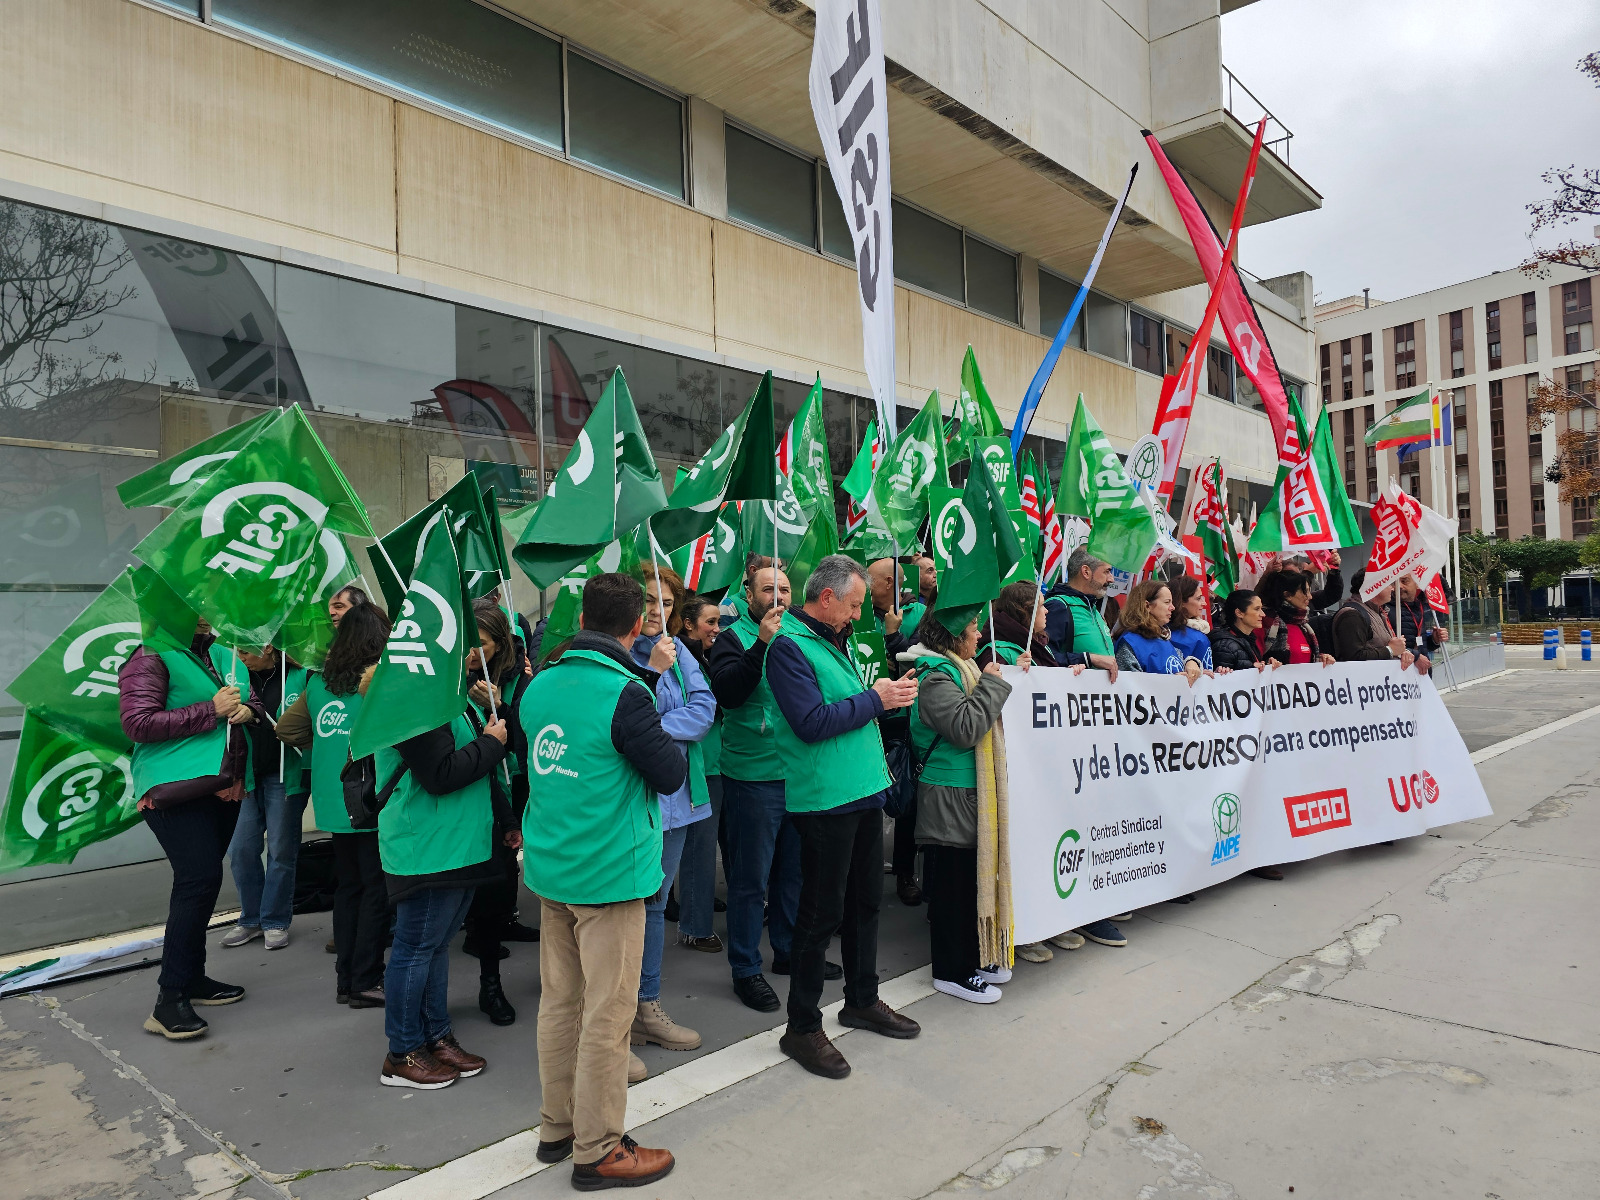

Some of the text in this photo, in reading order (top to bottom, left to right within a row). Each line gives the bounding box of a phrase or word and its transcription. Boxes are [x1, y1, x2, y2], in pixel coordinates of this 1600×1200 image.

[1031, 692, 1063, 728] En
[1067, 692, 1167, 728] DEFENSA
[1166, 695, 1190, 727] de
[1192, 694, 1210, 725] la
[1207, 681, 1320, 722] MOVLIDAD
[1324, 678, 1351, 706] del
[321, 711, 348, 726] CSIF
[539, 738, 568, 761] CSIF
[1072, 757, 1084, 794] y
[1089, 743, 1111, 781] de
[1114, 742, 1150, 777] los
[1152, 731, 1262, 773] RECURSO
[1264, 731, 1304, 763] para
[1387, 772, 1424, 813] UG
[1291, 796, 1347, 829] CCOO
[1090, 815, 1163, 842] Central Sindical
[1092, 841, 1165, 866] Independiente y
[1212, 833, 1241, 862] ANPE
[1058, 848, 1086, 876] CSIF
[1093, 862, 1167, 890] de Funcionarios
